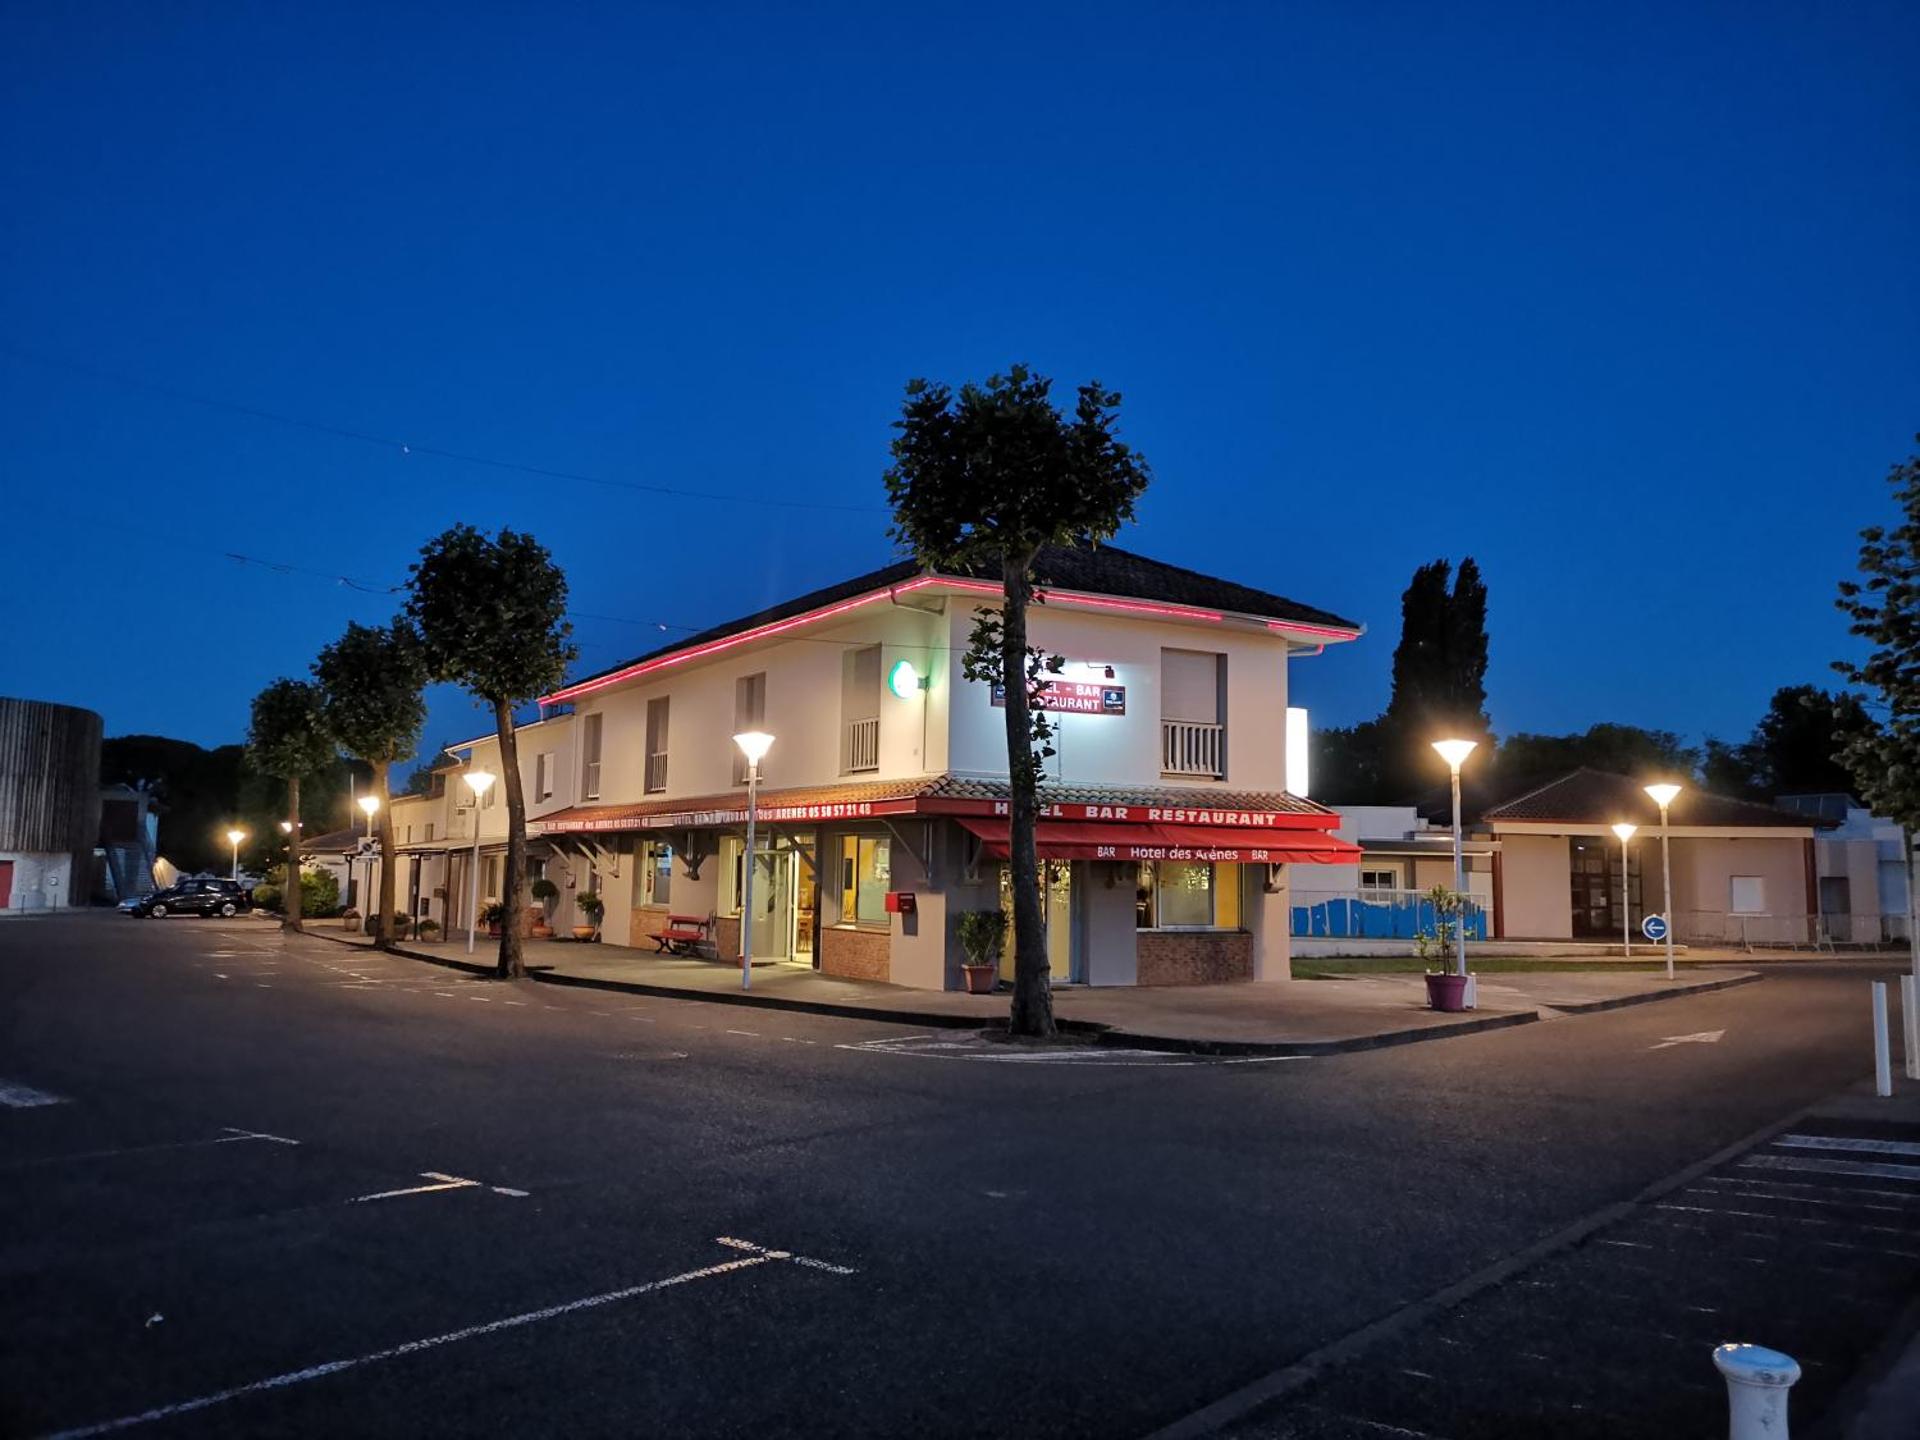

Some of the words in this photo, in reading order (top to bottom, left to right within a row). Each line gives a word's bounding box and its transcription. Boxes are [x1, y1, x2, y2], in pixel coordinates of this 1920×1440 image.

[1076, 685, 1101, 697] BAR
[808, 806, 820, 818] 05
[834, 804, 845, 816] 57
[846, 804, 857, 816] 21
[995, 801, 1063, 816] HEL
[1085, 806, 1128, 819] BAR
[1149, 808, 1276, 825] RESTAURANT
[1097, 846, 1116, 858] BAR
[1169, 847, 1192, 860] des
[1251, 849, 1269, 861] BAR
